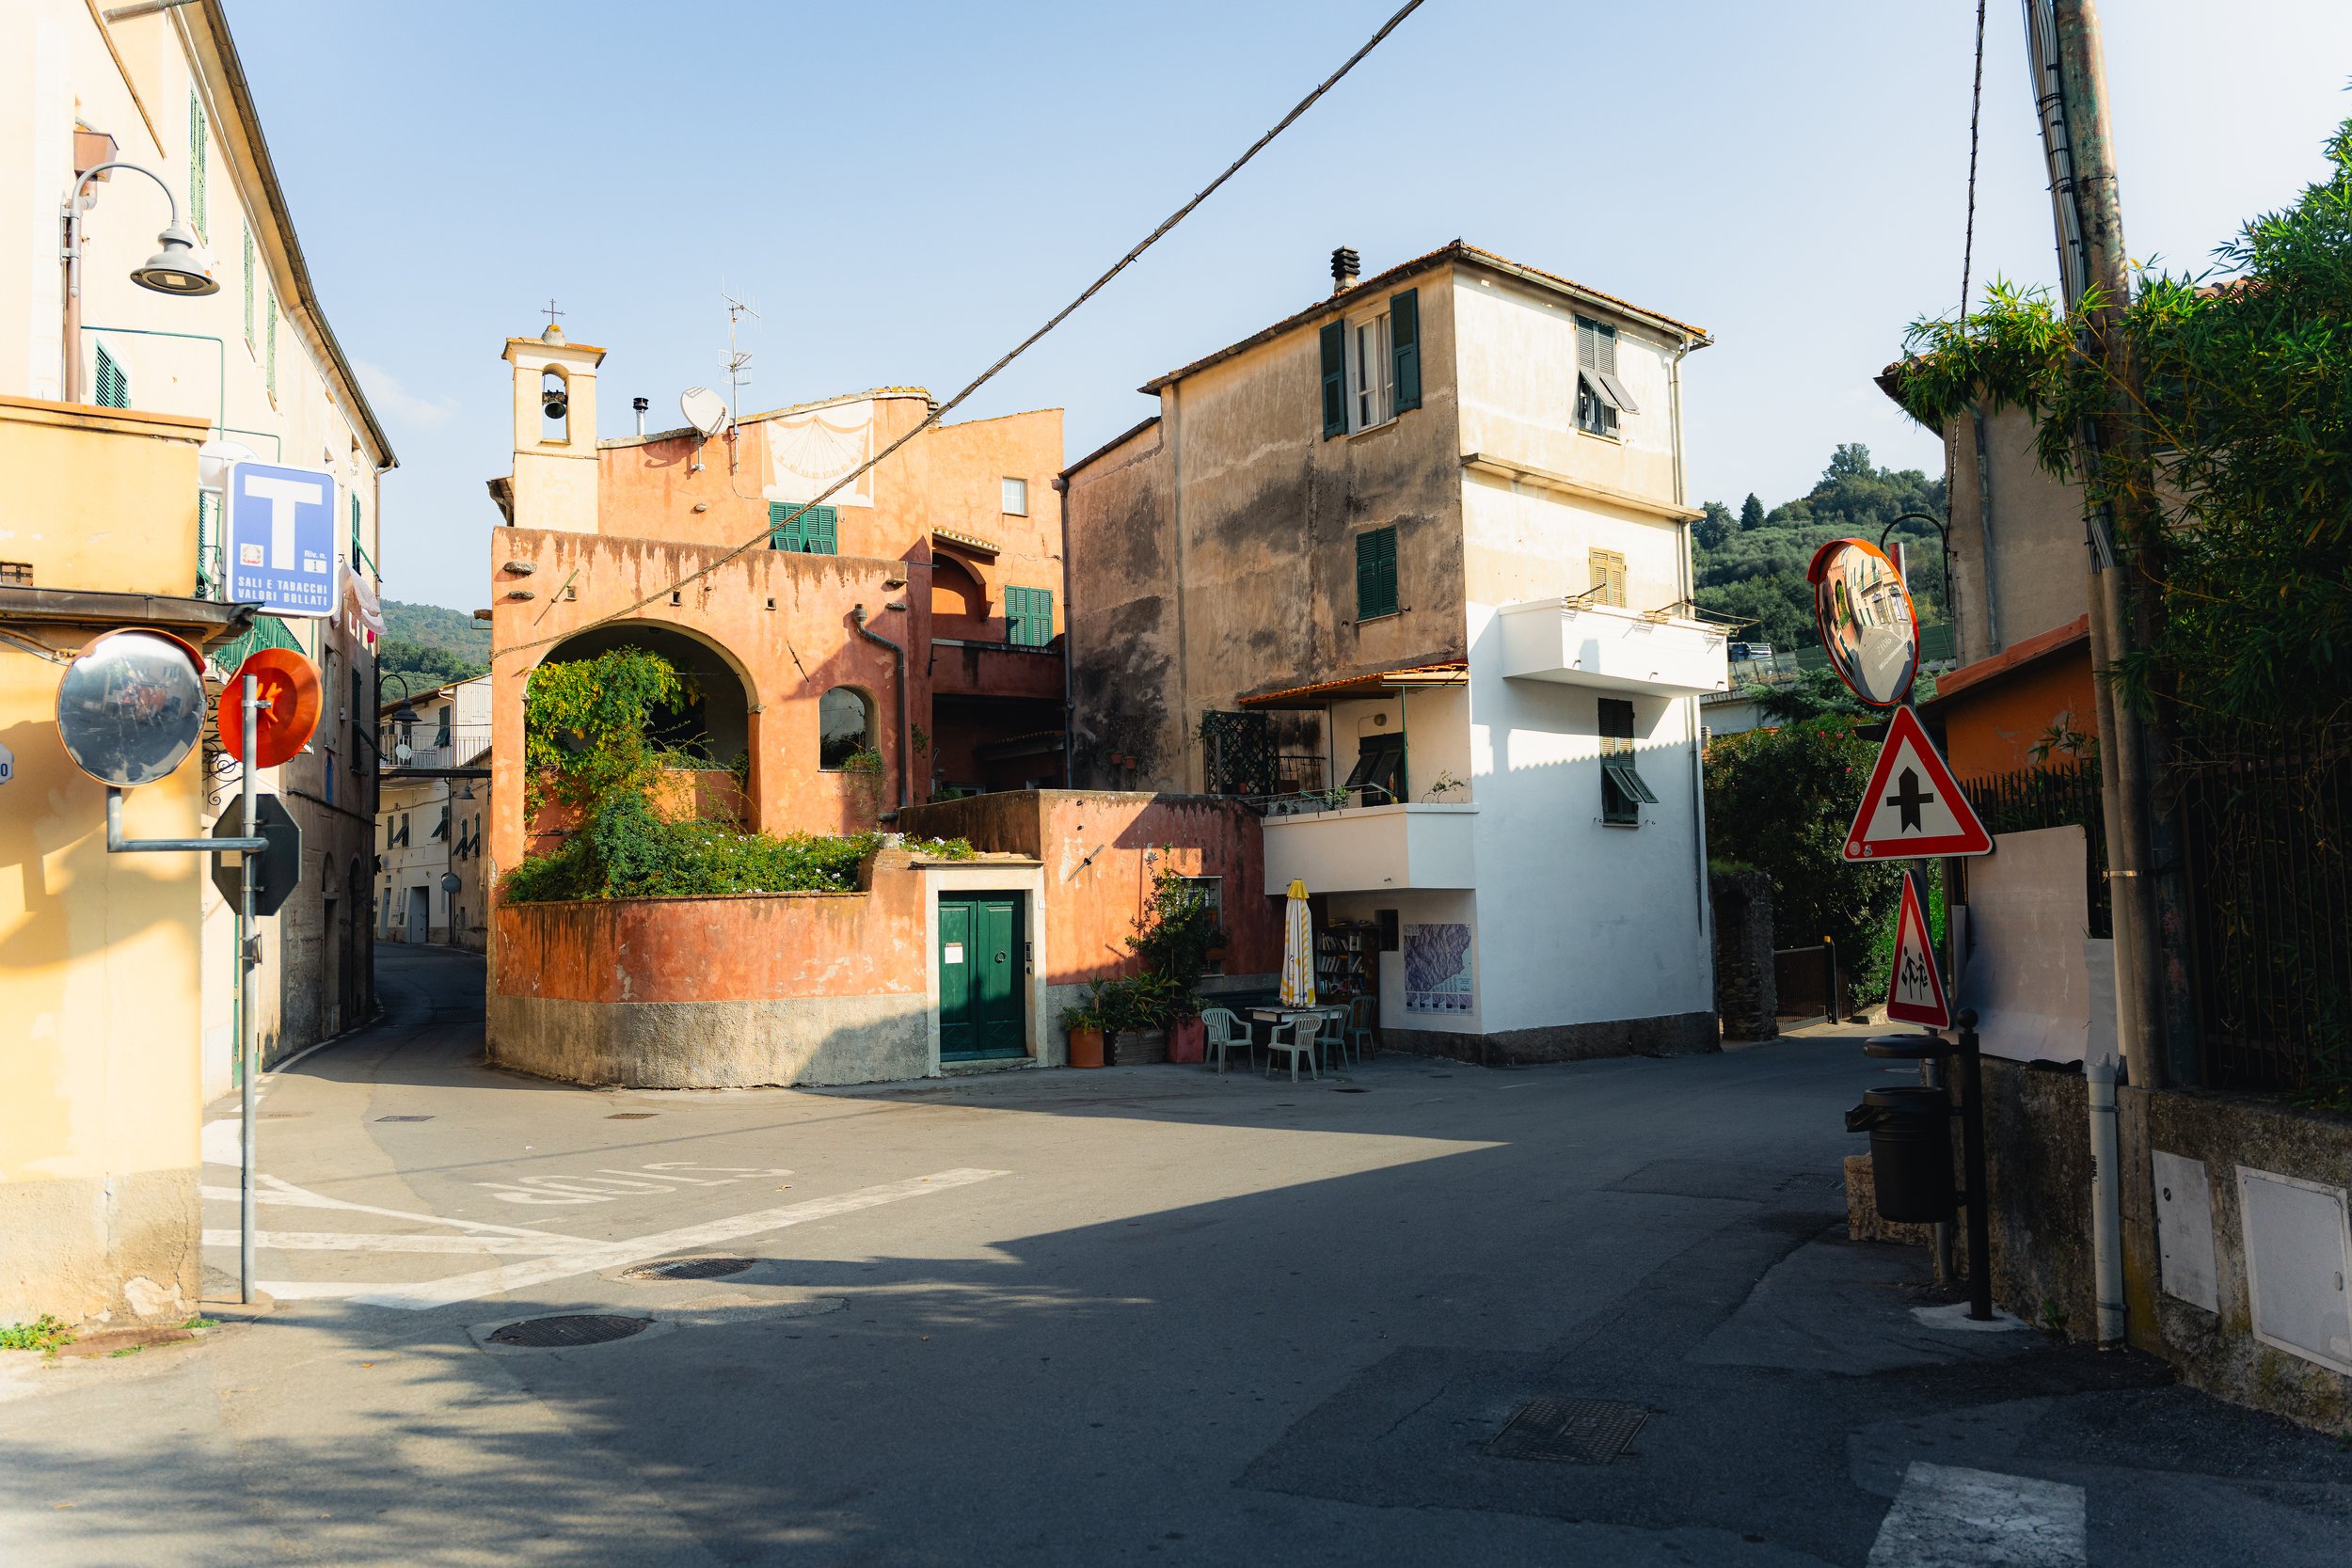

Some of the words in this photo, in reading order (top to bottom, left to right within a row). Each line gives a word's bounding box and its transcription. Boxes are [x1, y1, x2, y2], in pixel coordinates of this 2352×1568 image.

[245, 474, 323, 571] T
[304, 549, 318, 559] Riv.
[238, 576, 262, 589] SALI
[266, 578, 273, 589] E
[278, 580, 327, 594] TABACCHI
[238, 588, 277, 602] VALORI
[283, 593, 327, 607] BOLLATI
[470, 1162, 795, 1205] STOP
